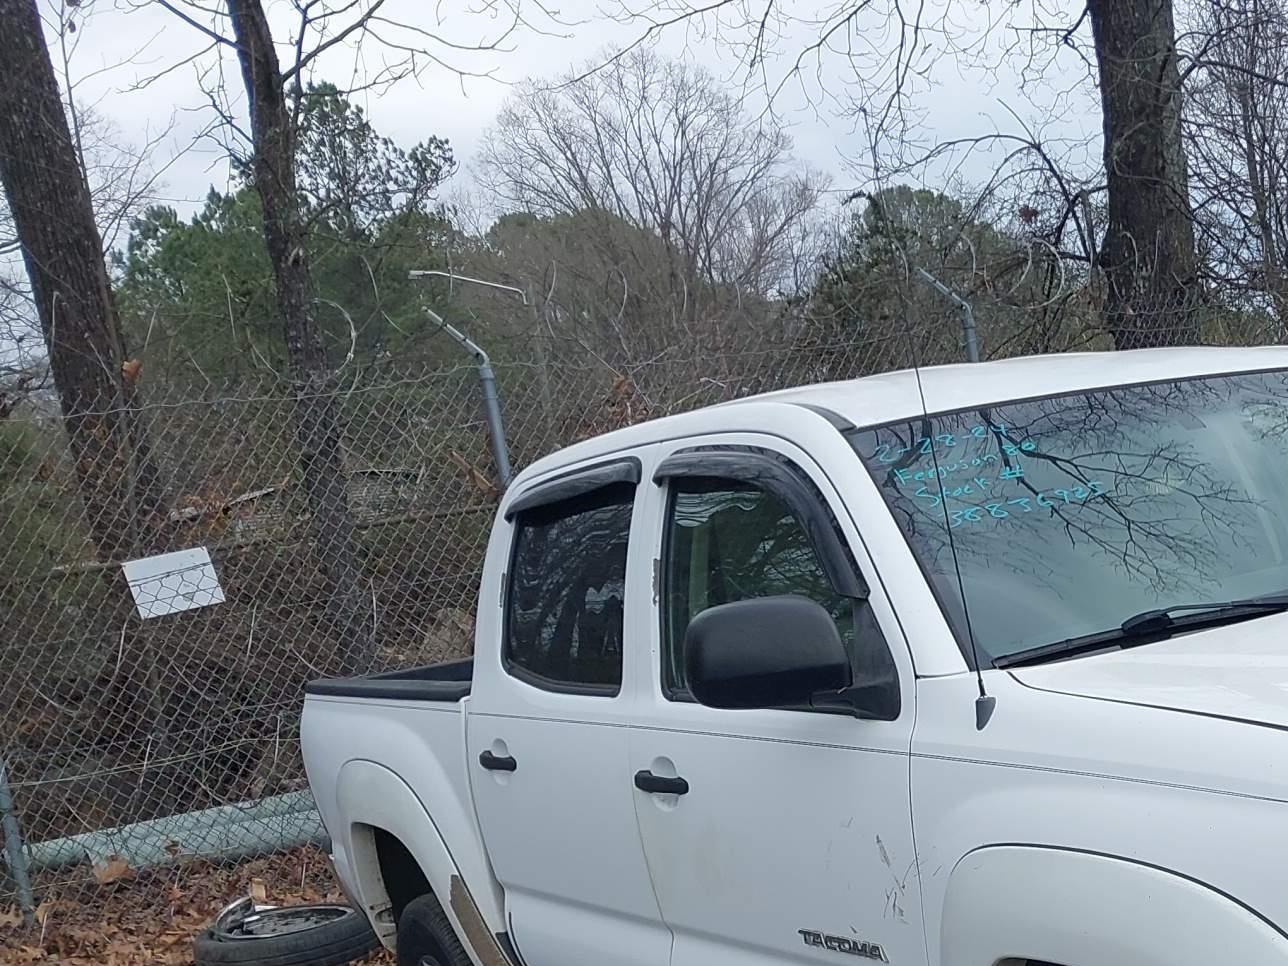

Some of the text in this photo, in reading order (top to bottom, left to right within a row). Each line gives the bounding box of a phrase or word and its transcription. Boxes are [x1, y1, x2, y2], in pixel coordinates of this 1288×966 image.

[875, 424, 1007, 462] 2-28-24
[1000, 466, 1024, 480] #
[939, 480, 1104, 528] 38836925
[798, 928, 890, 964] TACOMA
